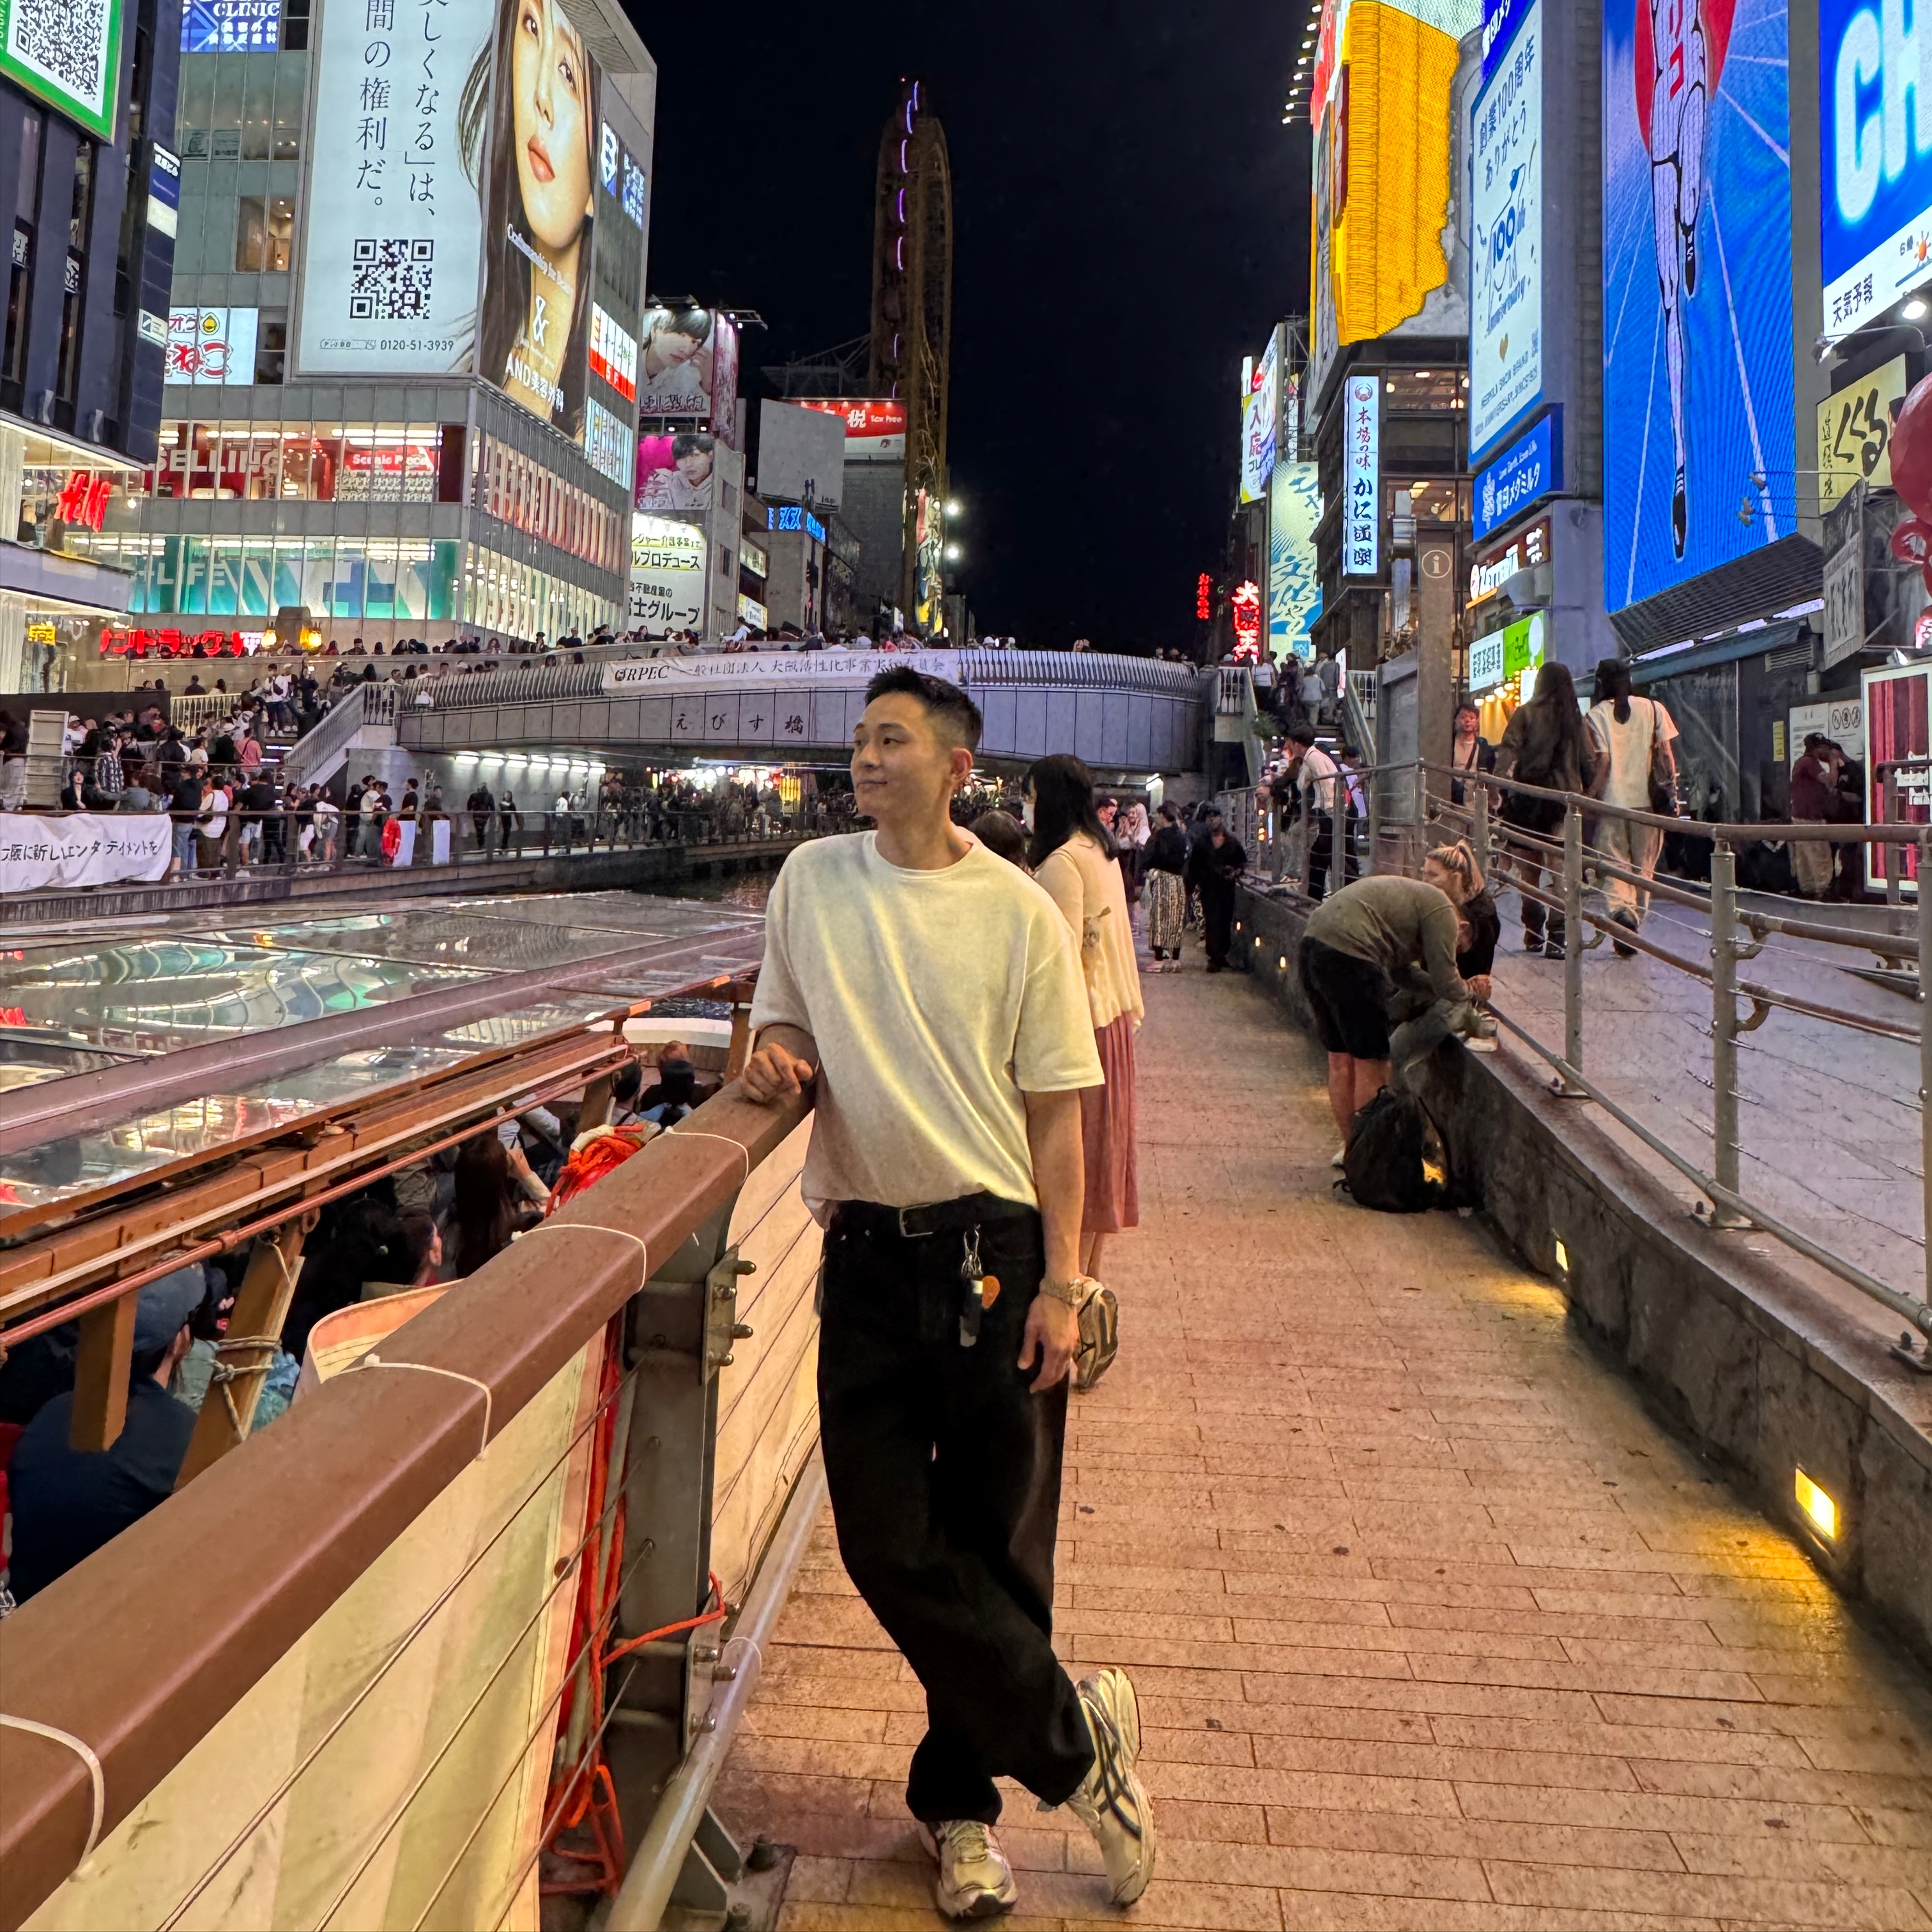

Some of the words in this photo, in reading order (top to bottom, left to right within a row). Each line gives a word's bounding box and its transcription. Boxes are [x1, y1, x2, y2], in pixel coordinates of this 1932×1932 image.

[213, 3, 280, 17] CLINIC
[404, 0, 448, 216] しくなる」は、
[1485, 100, 1526, 192] ありがとう
[380, 339, 454, 351] 0120-51-3939
[1355, 406, 1372, 471] 本場の味
[1833, 388, 1888, 477] くくる
[676, 712, 804, 735] えびす橋
